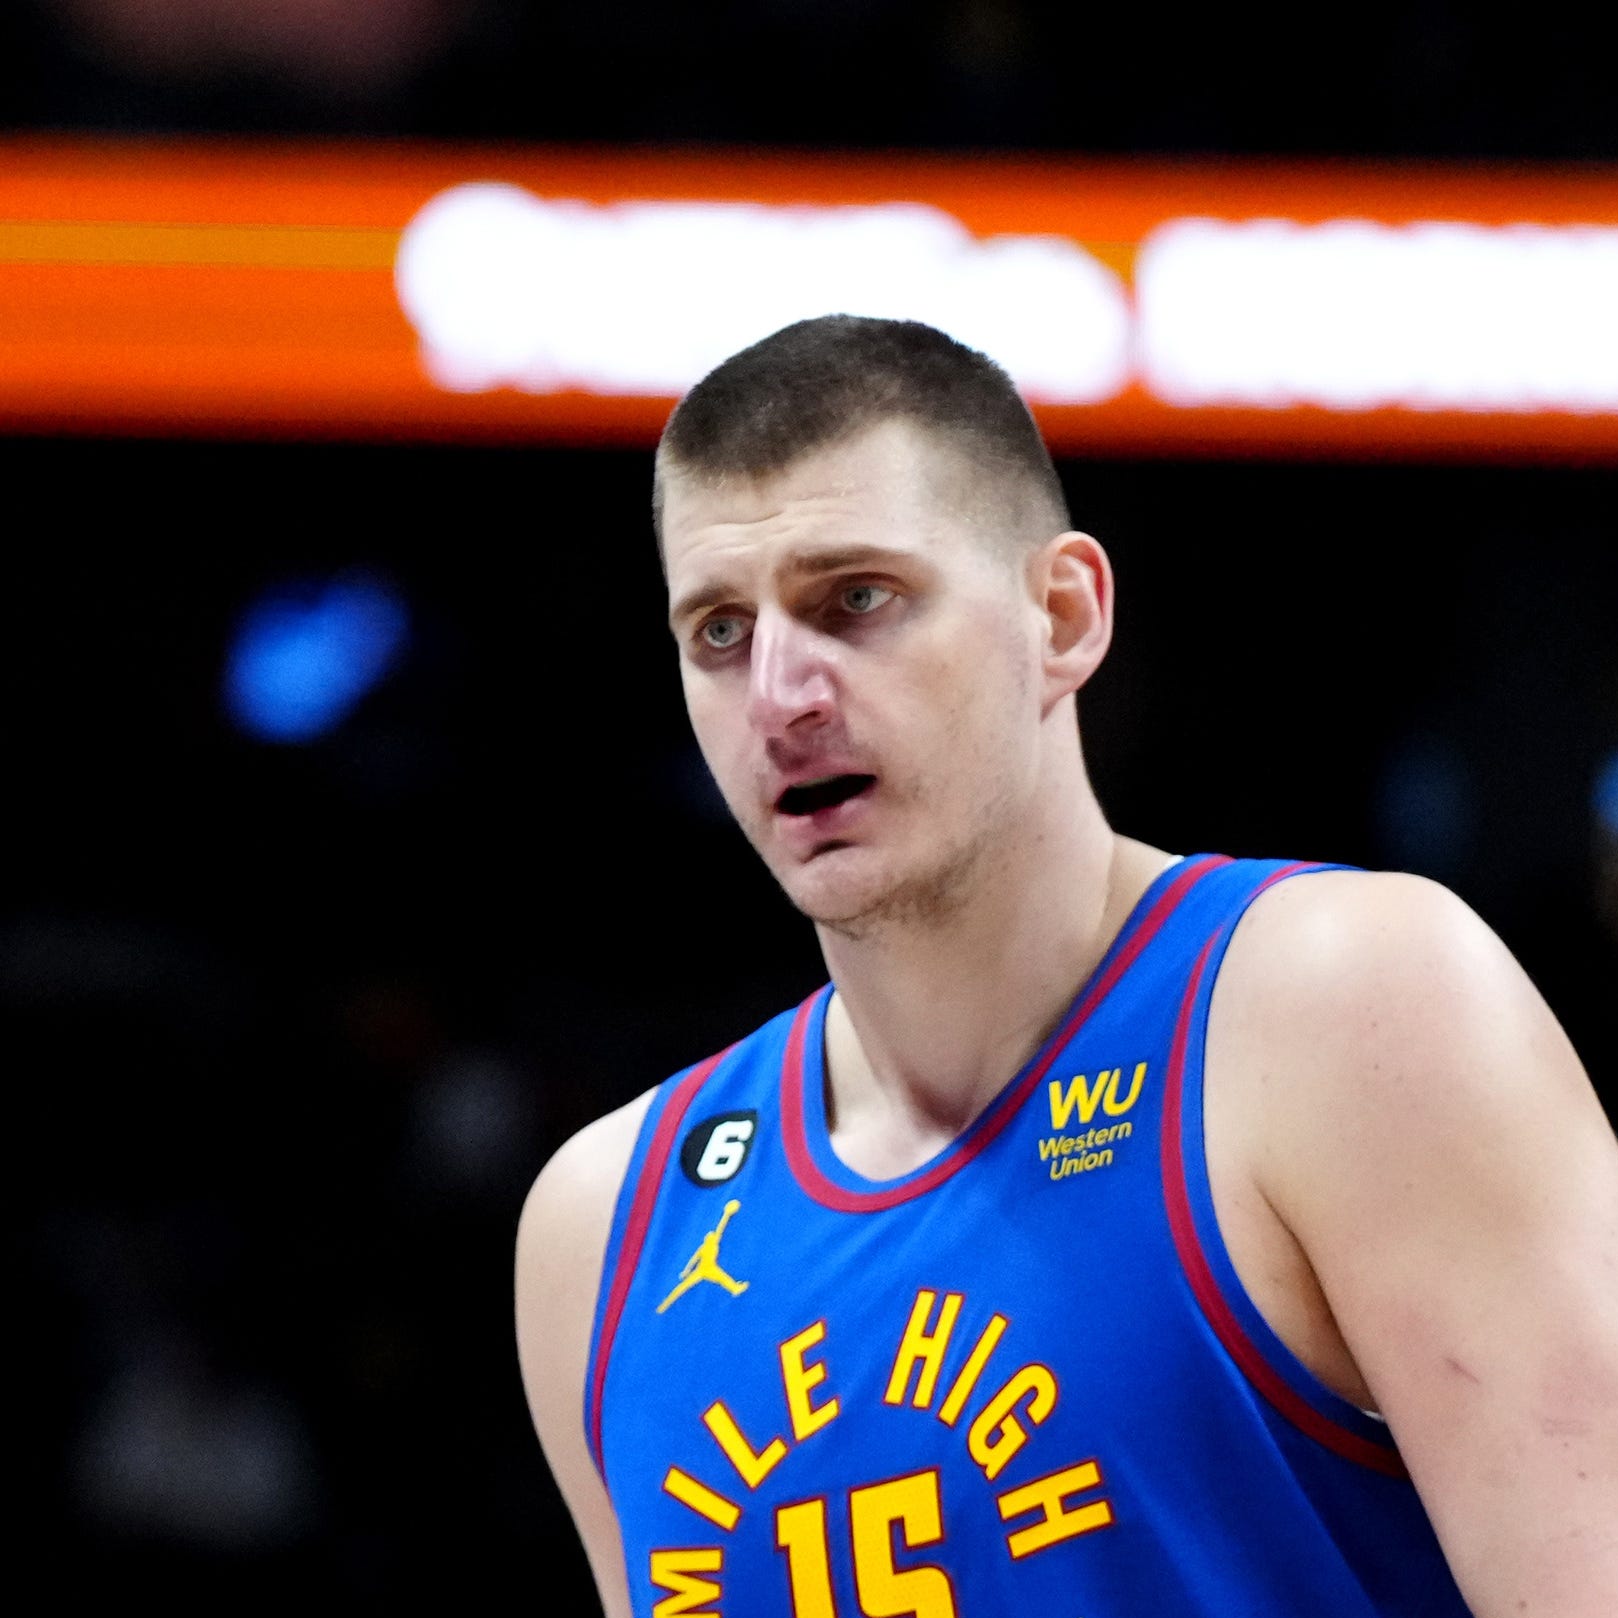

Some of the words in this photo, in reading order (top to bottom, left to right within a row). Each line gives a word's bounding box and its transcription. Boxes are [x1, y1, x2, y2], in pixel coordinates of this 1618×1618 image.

[1049, 1062, 1147, 1130] WU
[697, 1119, 753, 1180] 6
[1038, 1121, 1133, 1161] Western
[1050, 1149, 1113, 1180] Union
[883, 1289, 1113, 1559] HIGH
